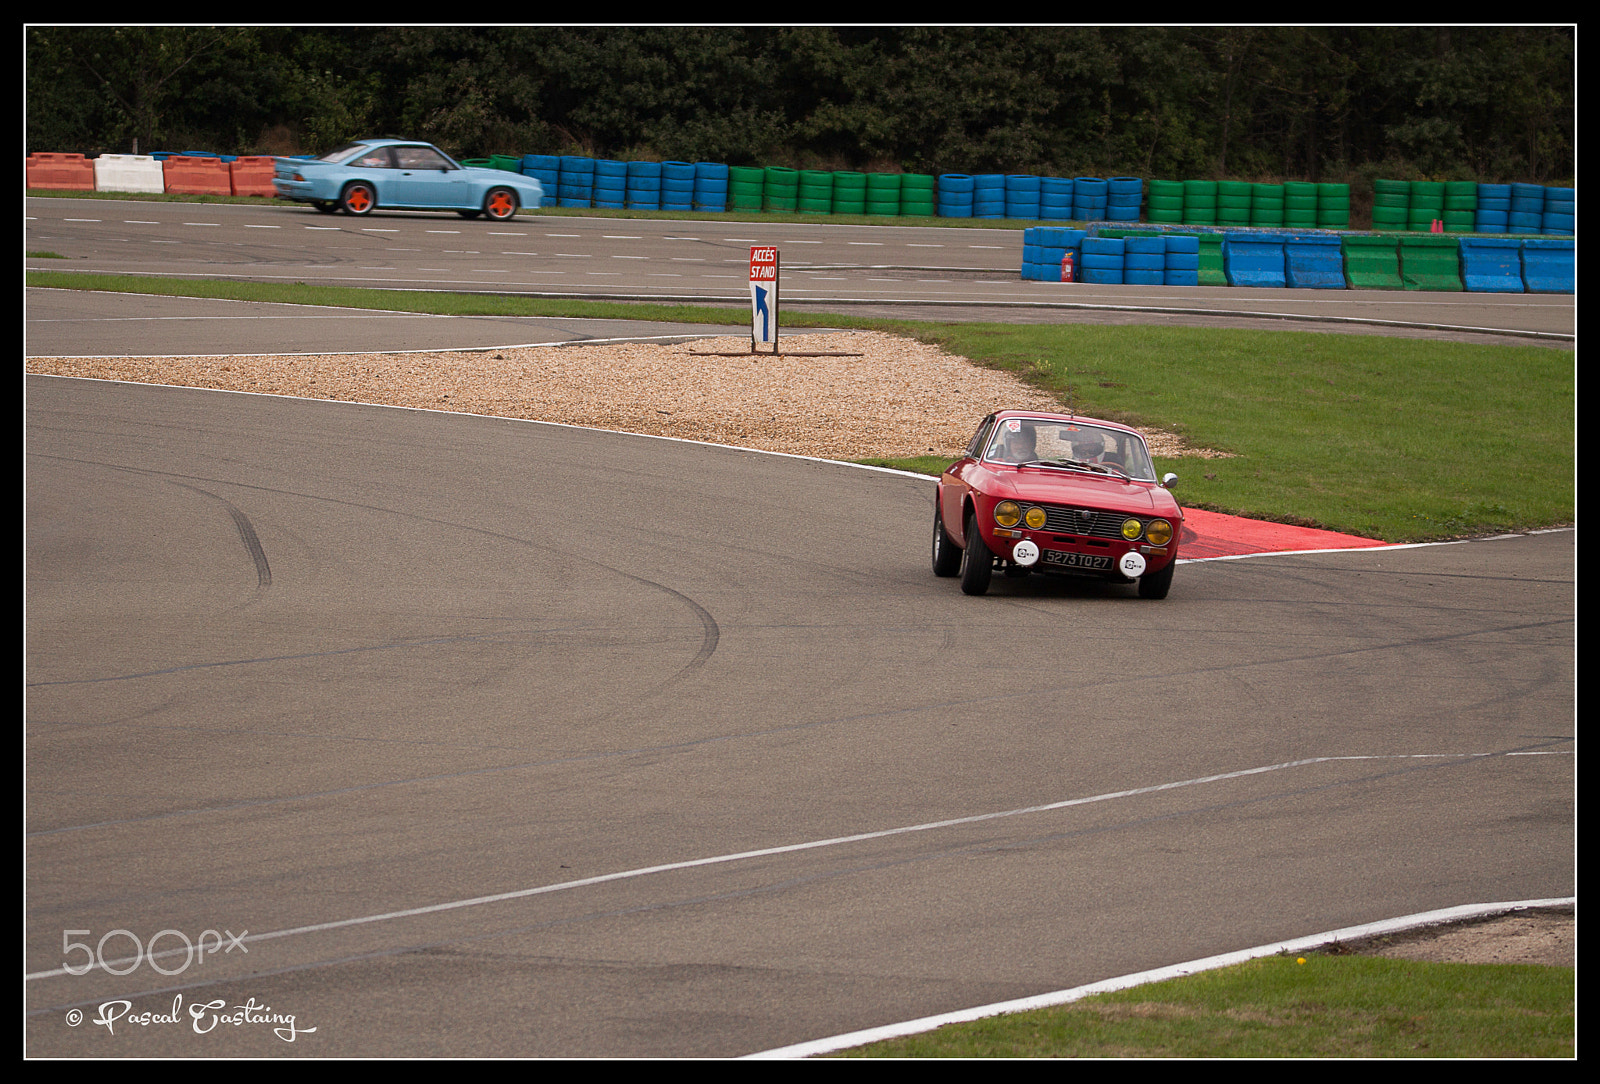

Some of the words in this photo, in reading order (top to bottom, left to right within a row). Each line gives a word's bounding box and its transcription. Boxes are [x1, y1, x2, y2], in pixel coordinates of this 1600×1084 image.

[751, 266, 775, 278] STAND
[1046, 551, 1077, 565] 5273
[1093, 557, 1109, 568] 27
